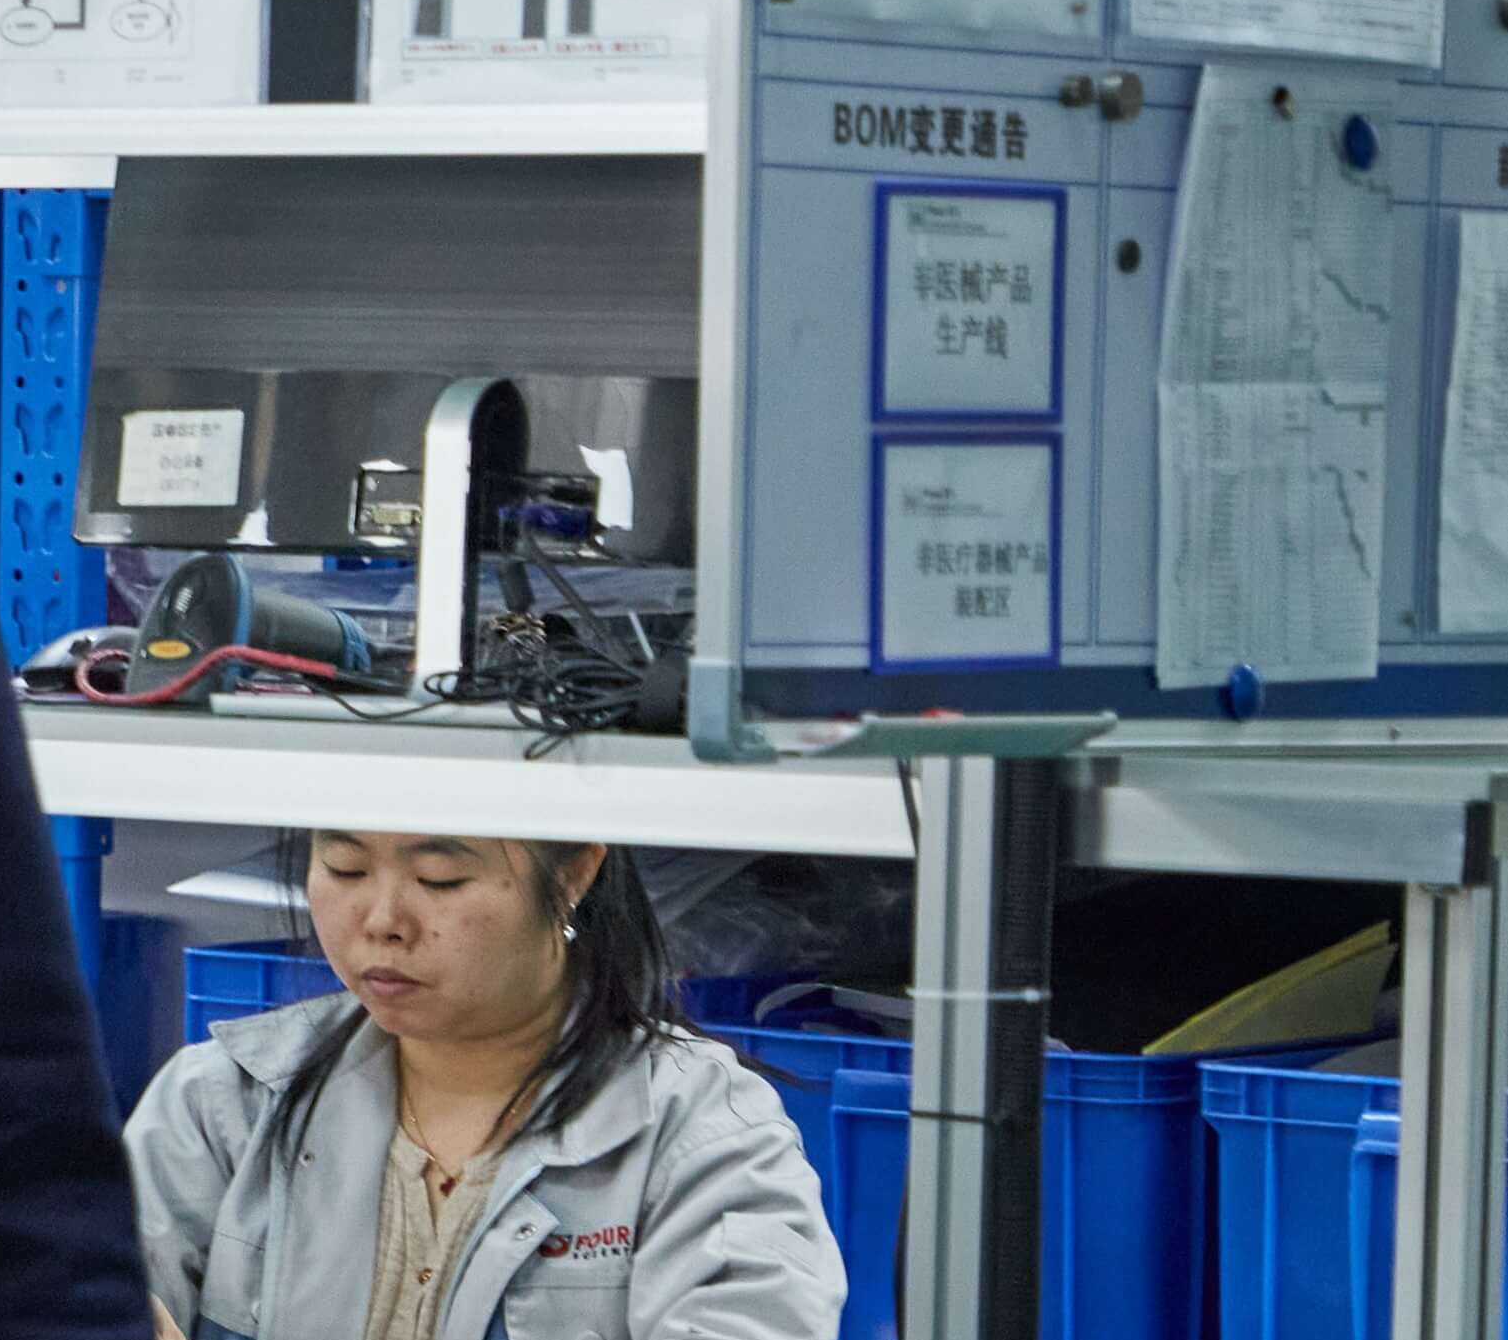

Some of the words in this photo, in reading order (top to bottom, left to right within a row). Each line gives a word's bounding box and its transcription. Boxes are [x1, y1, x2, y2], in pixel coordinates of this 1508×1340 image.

[833, 103, 1029, 161] BOM变更通告
[934, 314, 1010, 360] 生产线
